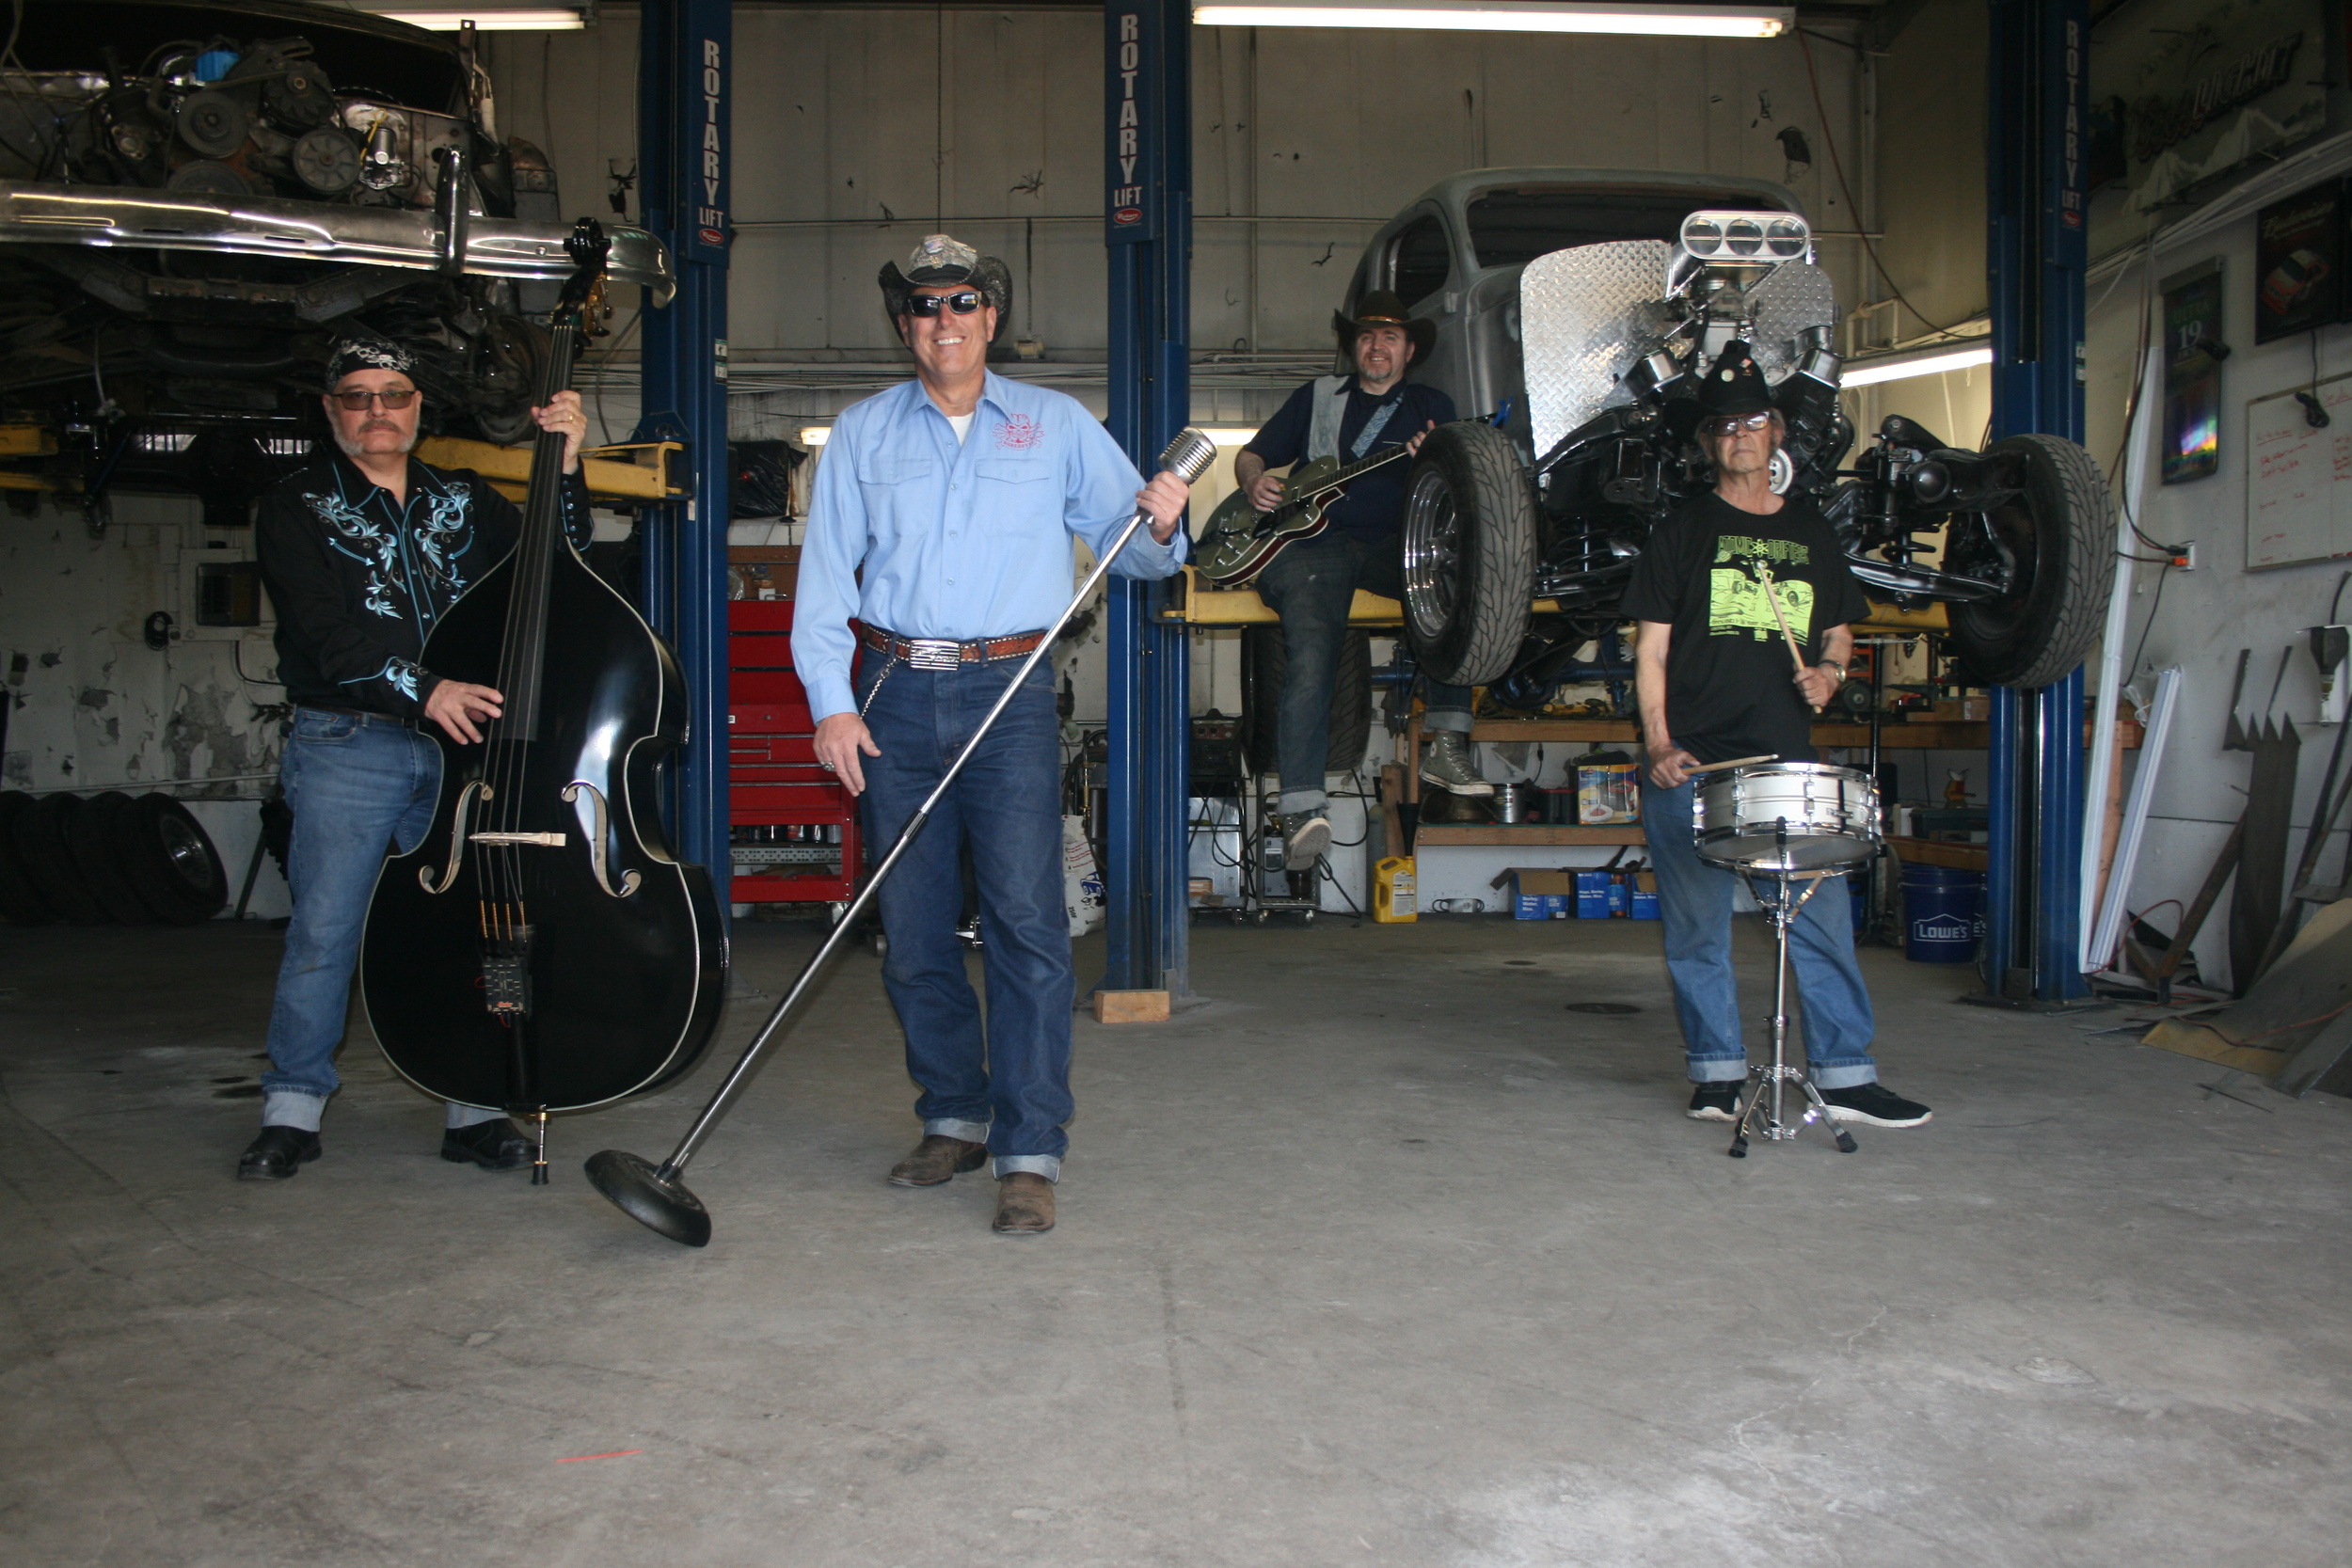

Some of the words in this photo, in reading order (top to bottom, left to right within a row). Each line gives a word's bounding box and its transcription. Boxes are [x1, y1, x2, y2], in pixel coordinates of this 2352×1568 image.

[1119, 13, 1138, 184] ROTARY
[2065, 19, 2079, 188] ROTARY
[703, 39, 721, 206] ROTARY
[1114, 186, 1142, 208] LIFT
[2061, 189, 2081, 212] LIFT
[699, 206, 723, 229] LIFT
[2178, 320, 2202, 350] 19
[1718, 535, 1753, 558] ATOMIC
[1767, 538, 1809, 564] DRIFTERS
[1919, 924, 1967, 939] LOWE'S
